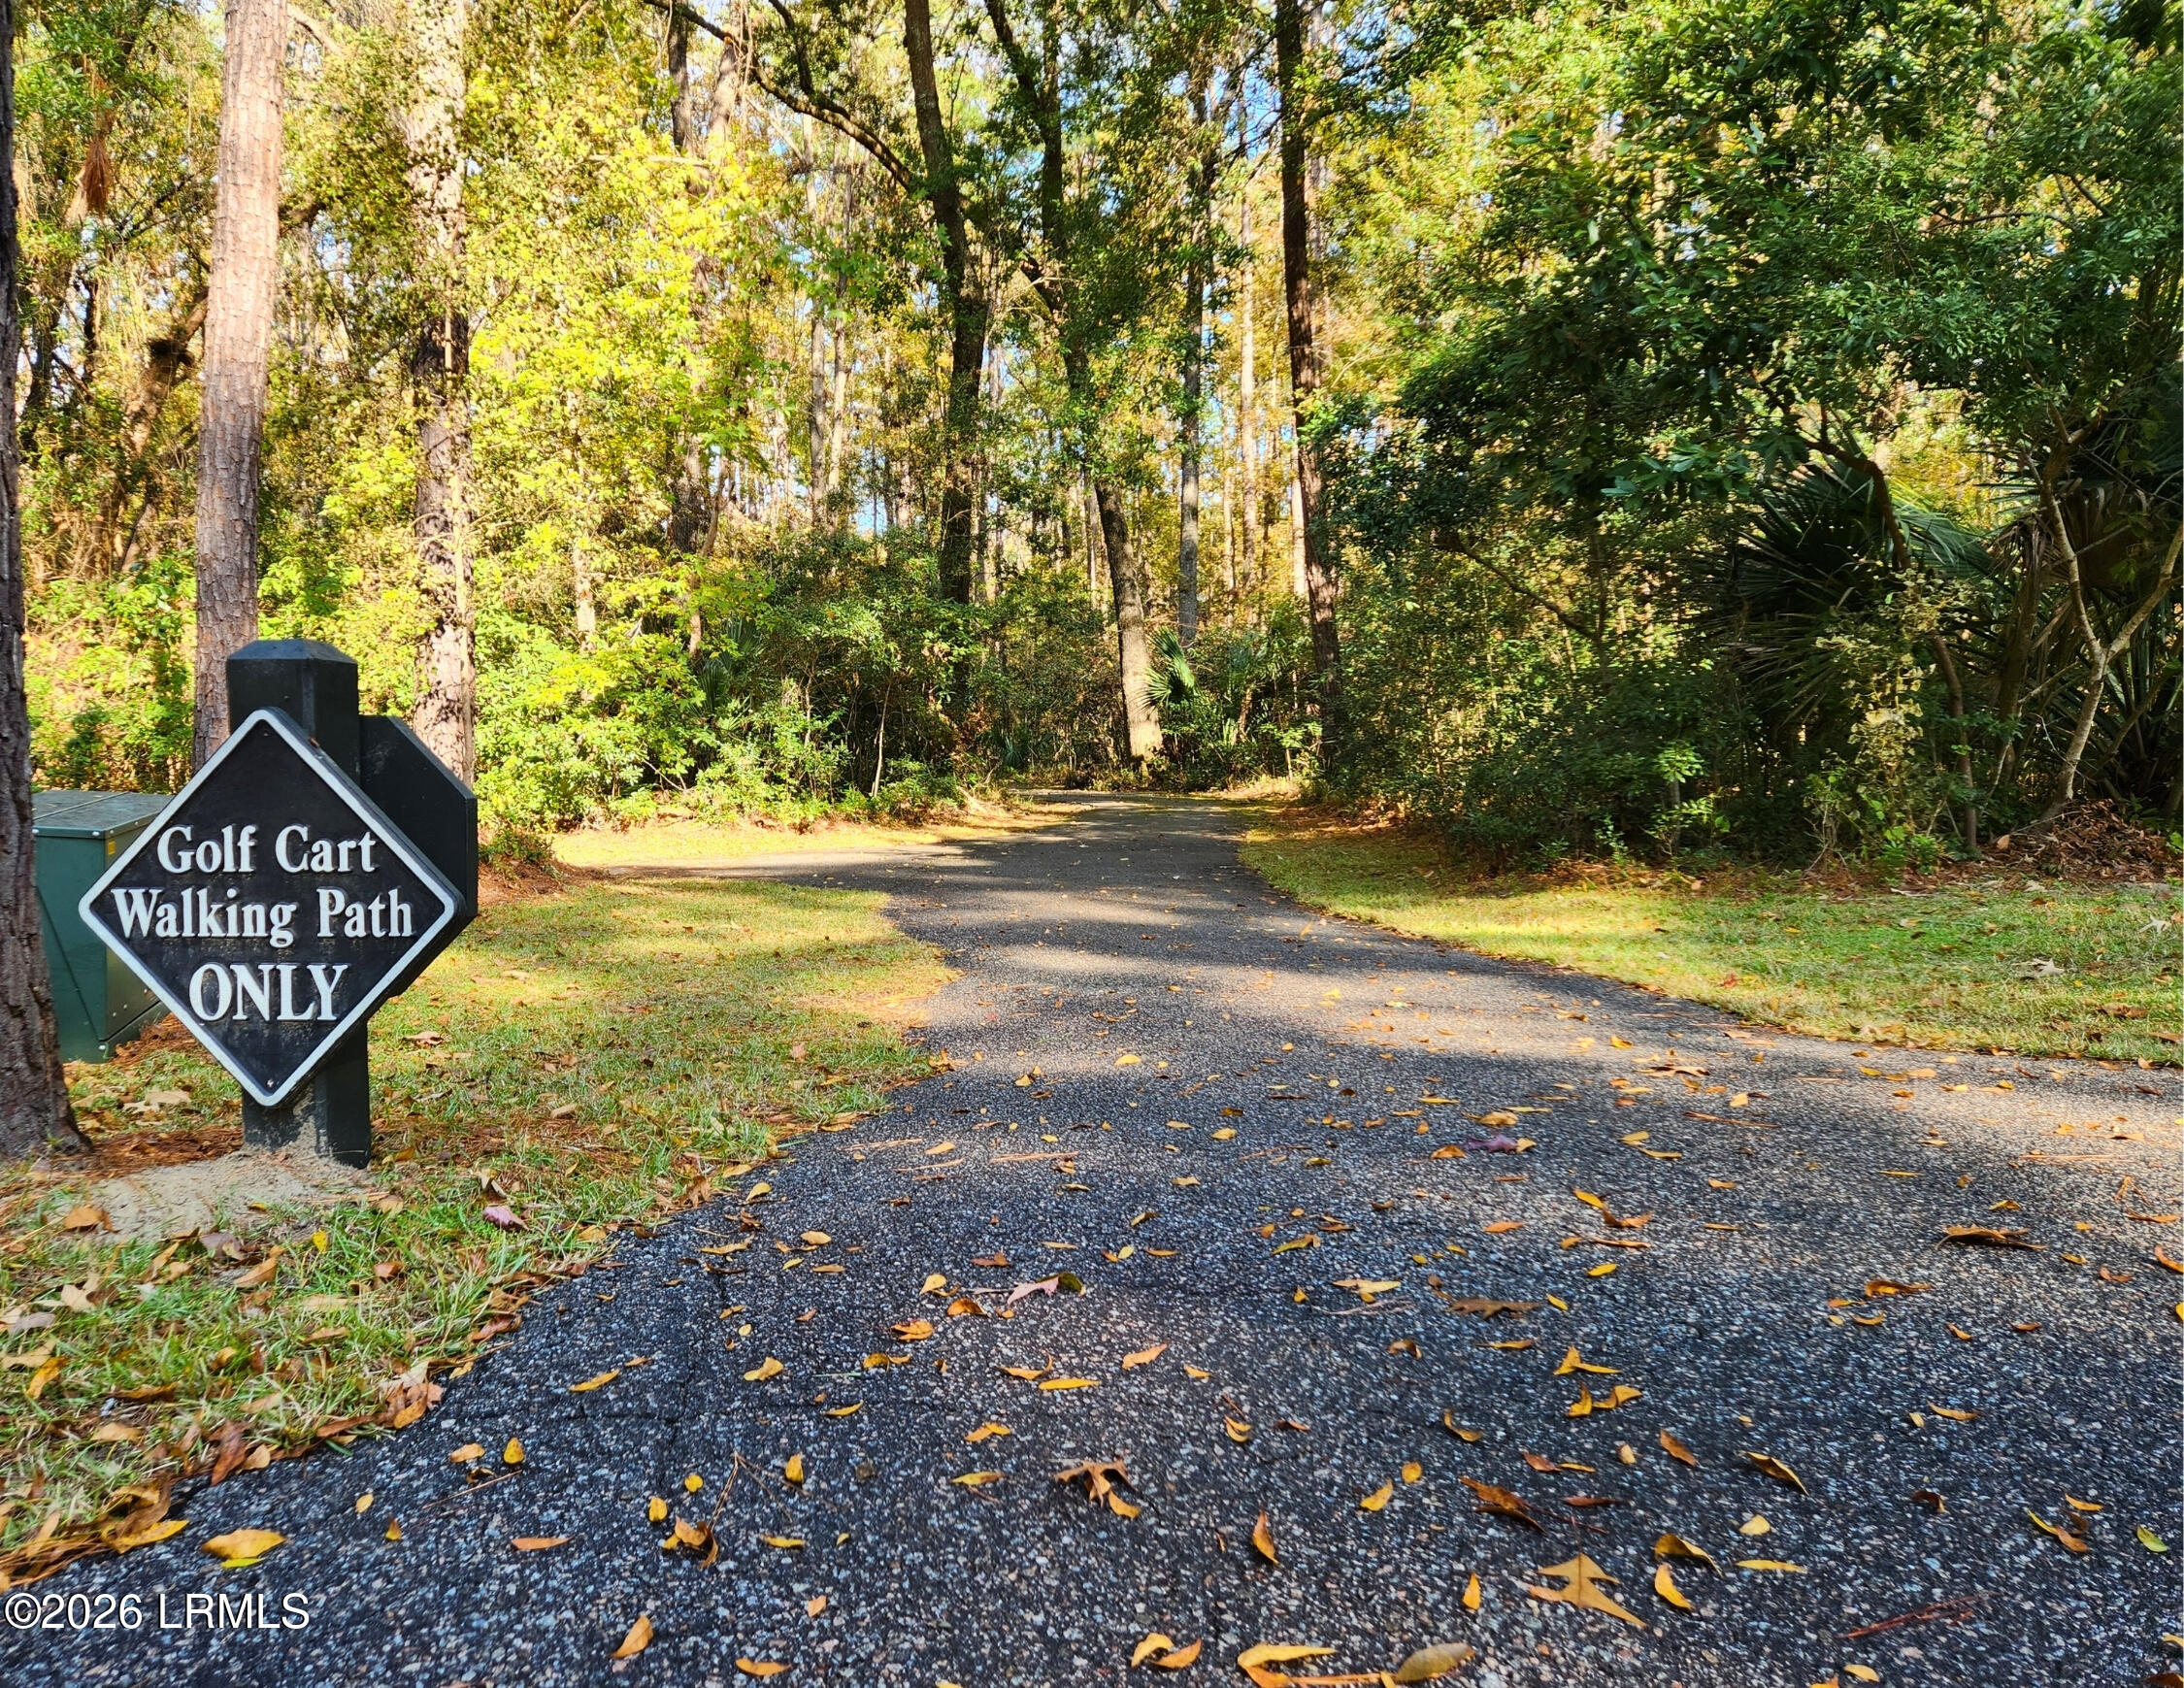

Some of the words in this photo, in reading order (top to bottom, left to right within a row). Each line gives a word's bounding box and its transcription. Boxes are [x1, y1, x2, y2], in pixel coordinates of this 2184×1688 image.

[156, 824, 257, 874] Golf
[275, 824, 378, 874] Cart
[111, 886, 297, 948] Walking
[315, 887, 413, 938] Path
[188, 962, 349, 1022] ONLY
